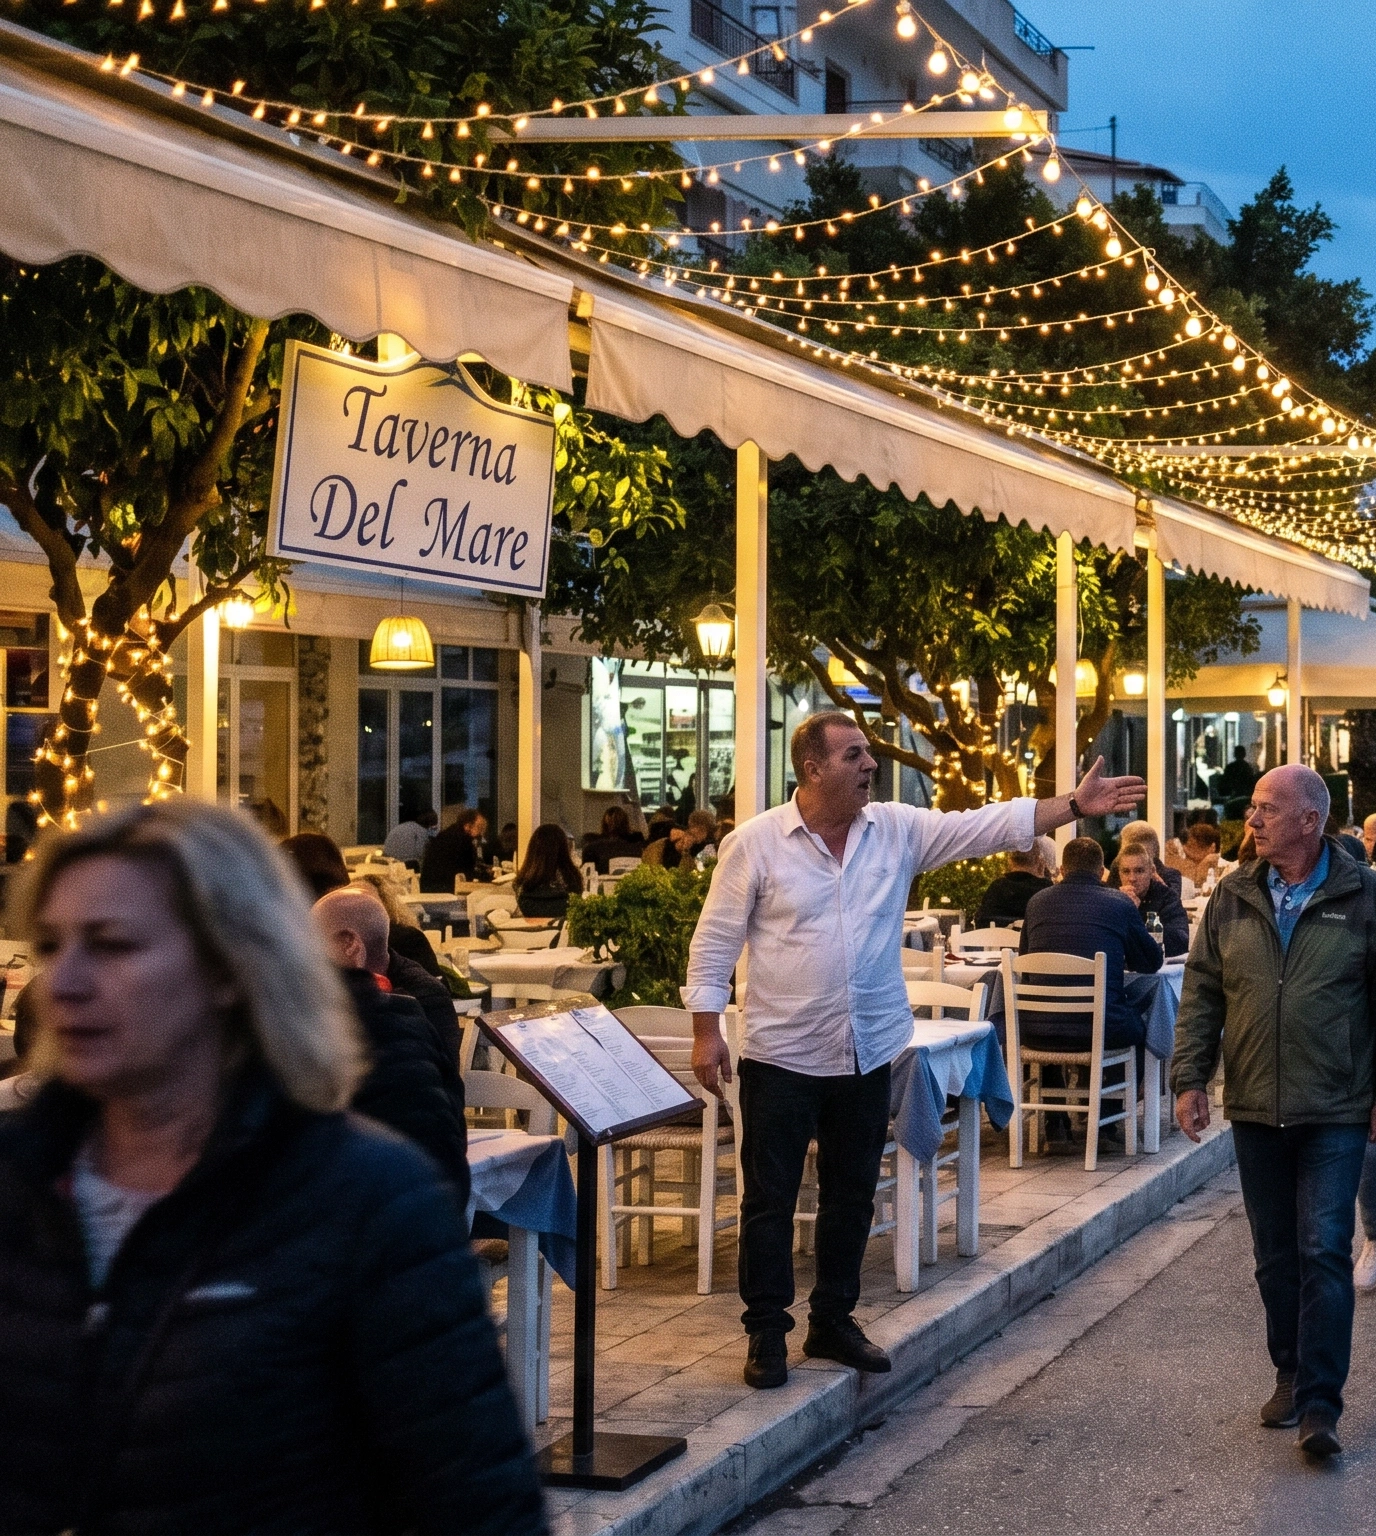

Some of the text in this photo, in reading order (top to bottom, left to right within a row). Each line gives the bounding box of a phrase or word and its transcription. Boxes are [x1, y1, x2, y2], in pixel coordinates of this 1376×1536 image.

[343, 384, 517, 485] Taverna
[310, 474, 529, 571] Del Mare
